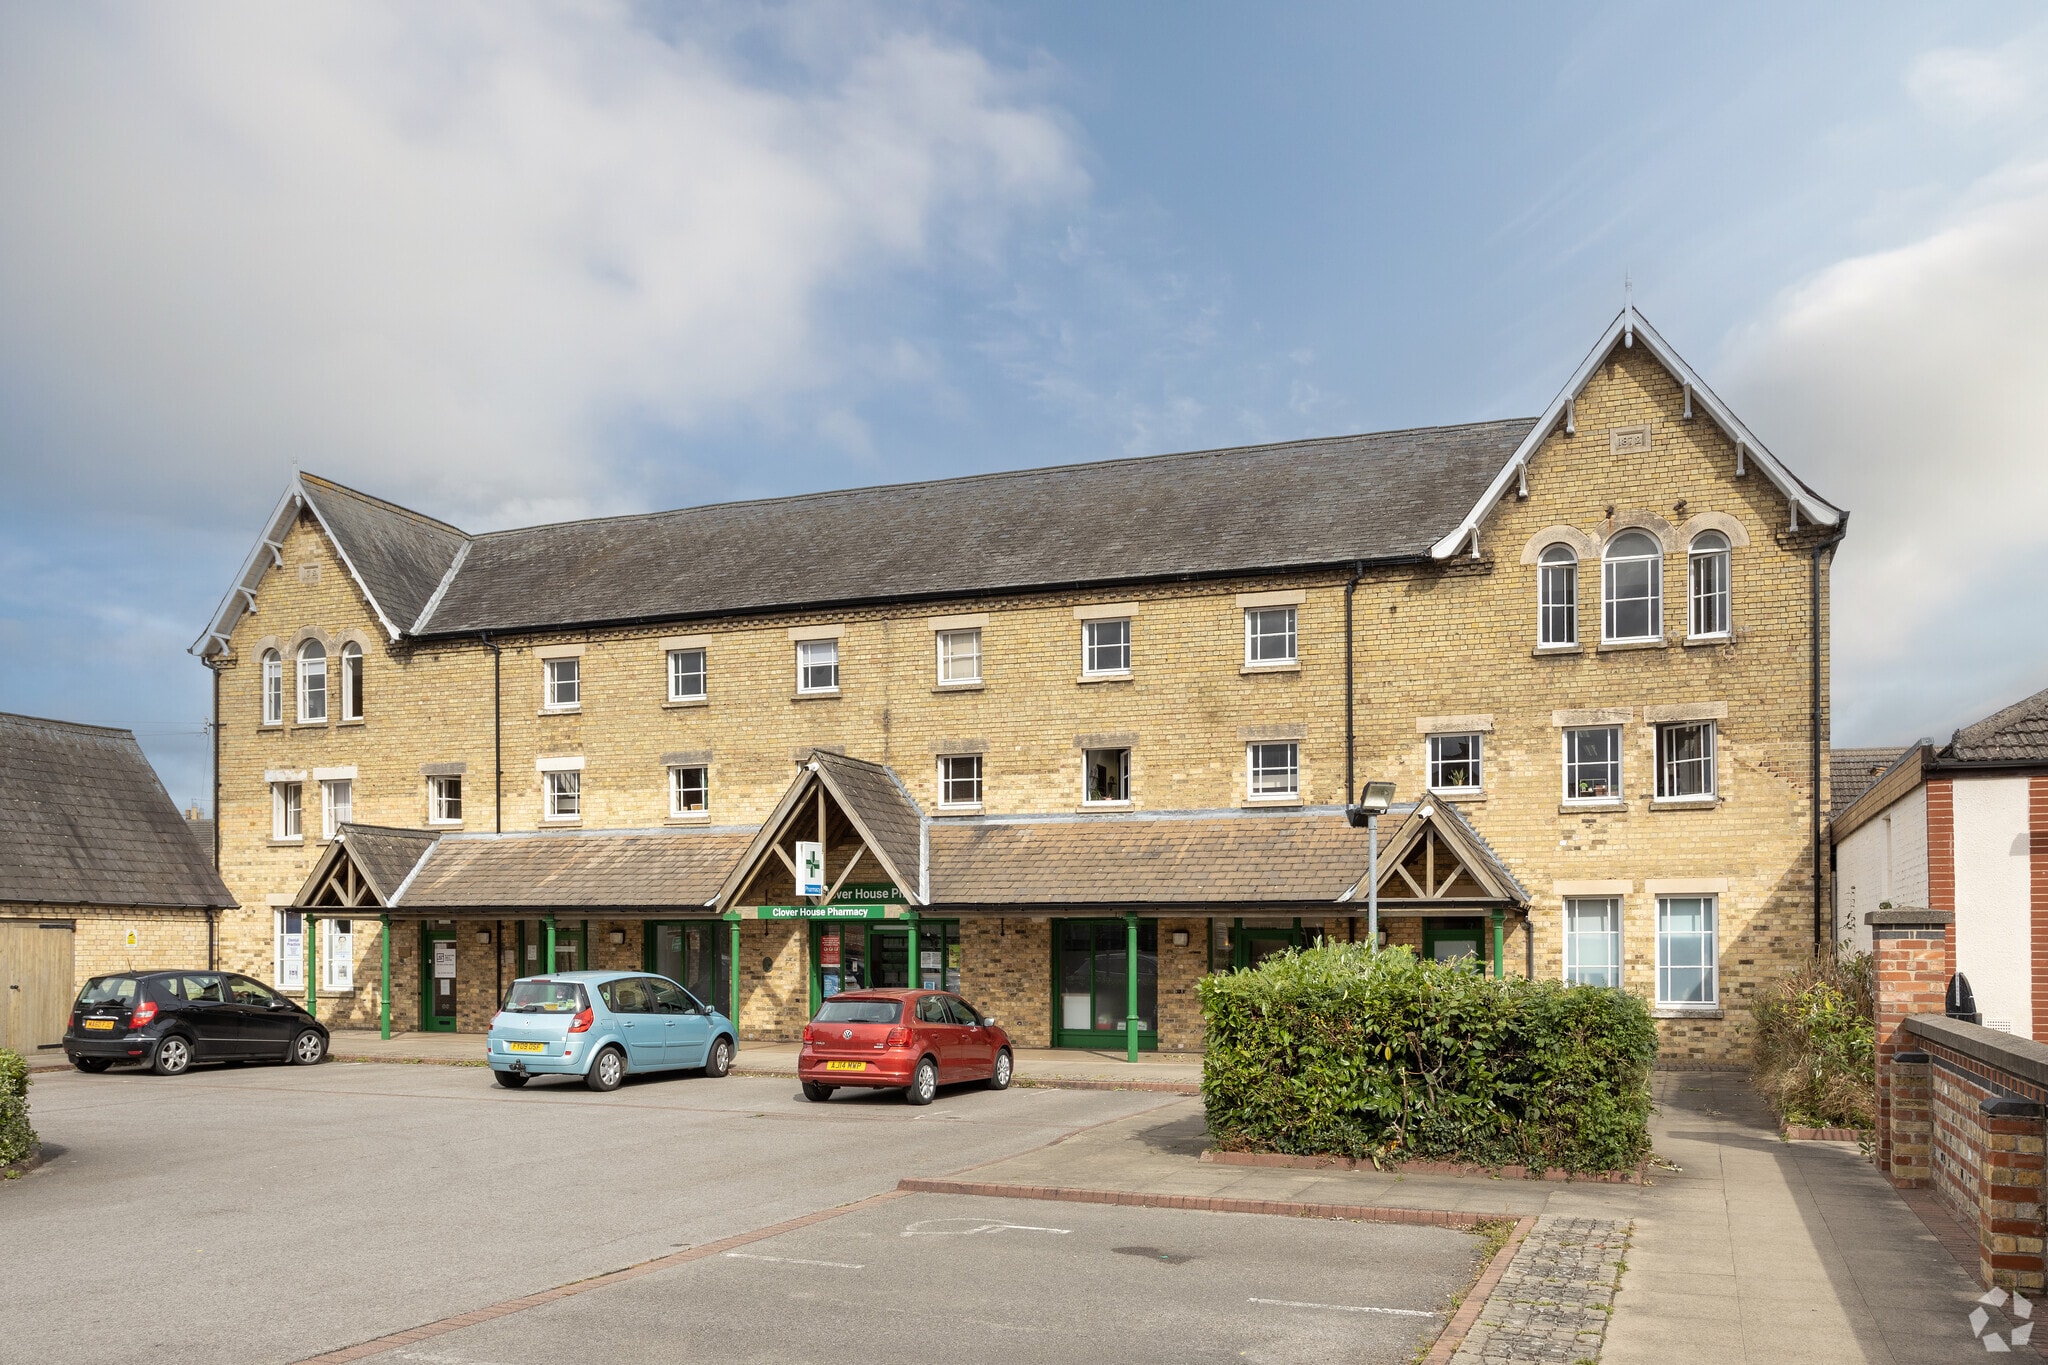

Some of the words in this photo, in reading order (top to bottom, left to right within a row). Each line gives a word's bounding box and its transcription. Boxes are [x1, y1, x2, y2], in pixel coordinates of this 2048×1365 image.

[855, 888, 889, 899] House
[772, 907, 798, 917] Clover
[800, 907, 826, 916] House
[827, 907, 868, 918] Pharmacy
